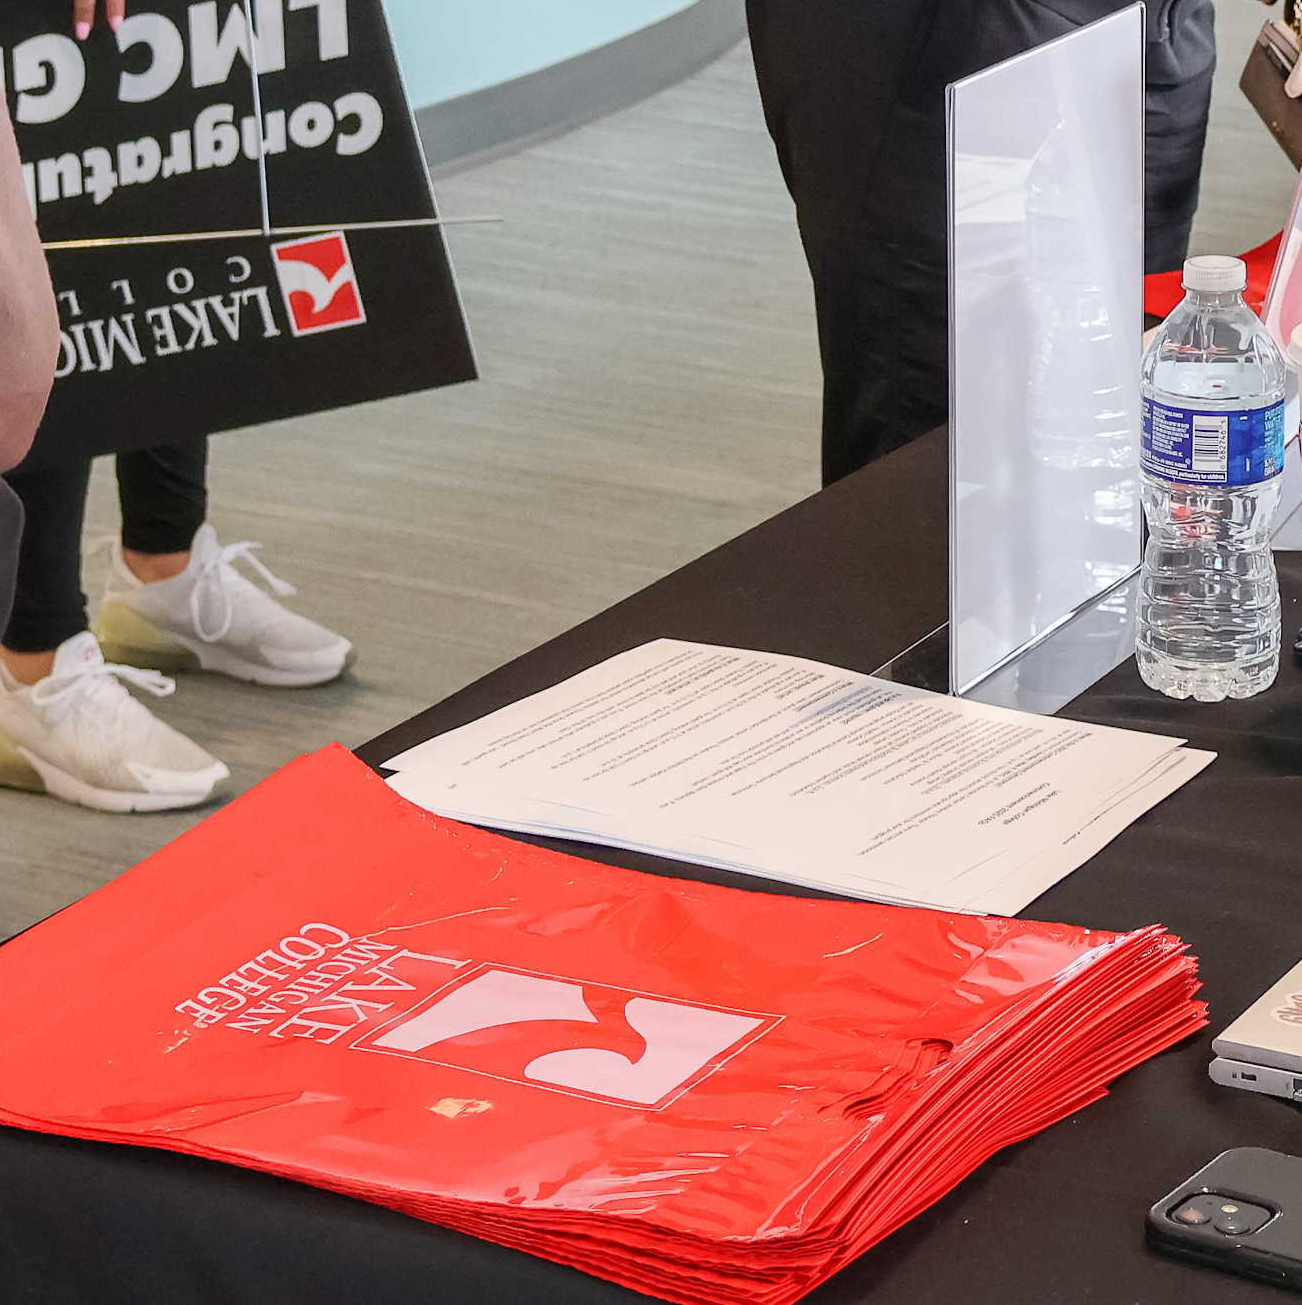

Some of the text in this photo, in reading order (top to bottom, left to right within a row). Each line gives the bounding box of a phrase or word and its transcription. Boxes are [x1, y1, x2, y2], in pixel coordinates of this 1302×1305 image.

[54, 286, 281, 378] LAKE MIC
[175, 922, 349, 1024] COLLEGE
[226, 937, 398, 1034] MICHIGAN
[269, 949, 472, 1044] LAKE
